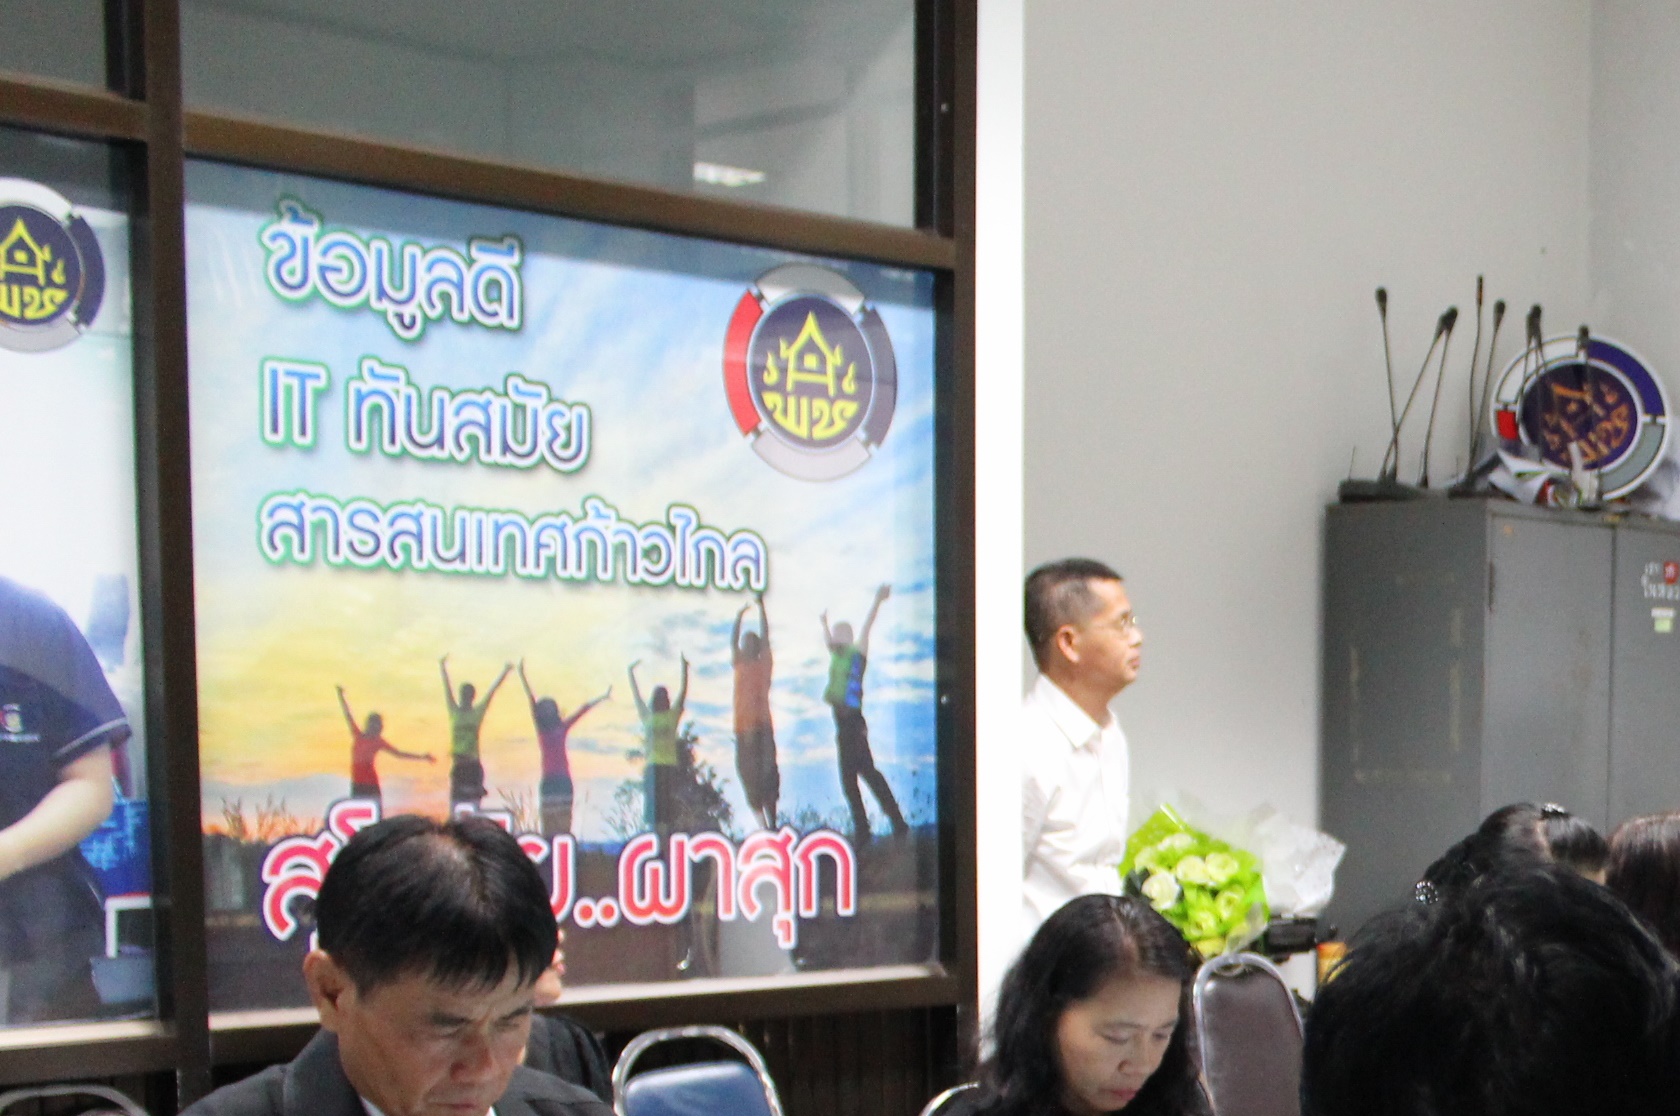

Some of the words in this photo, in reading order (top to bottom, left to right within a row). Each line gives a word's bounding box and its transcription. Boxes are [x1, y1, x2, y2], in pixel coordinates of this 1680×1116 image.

[264, 201, 521, 338] ข้อมูลดี
[264, 360, 326, 442] IT
[348, 358, 589, 469] ทันสมัย
[263, 492, 765, 590] สารสนเทศก้าวไกล
